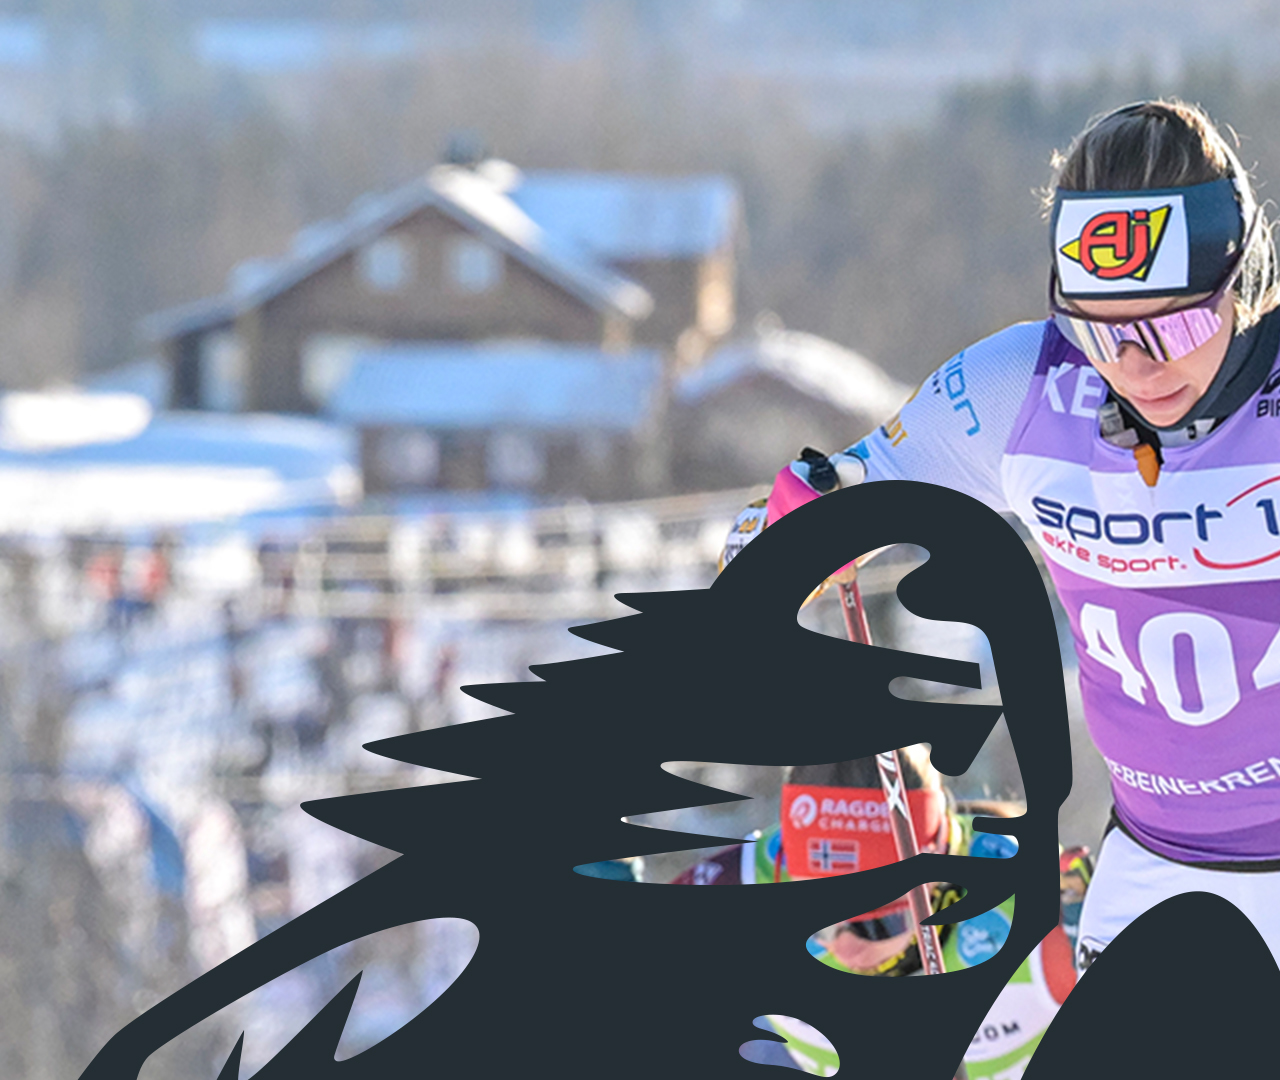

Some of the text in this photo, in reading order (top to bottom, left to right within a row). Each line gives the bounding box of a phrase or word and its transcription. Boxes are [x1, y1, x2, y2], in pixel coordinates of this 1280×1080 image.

[1042, 362, 1108, 419] KE
[1032, 496, 1280, 545] sport 1
[1042, 531, 1188, 573] ekte sport.
